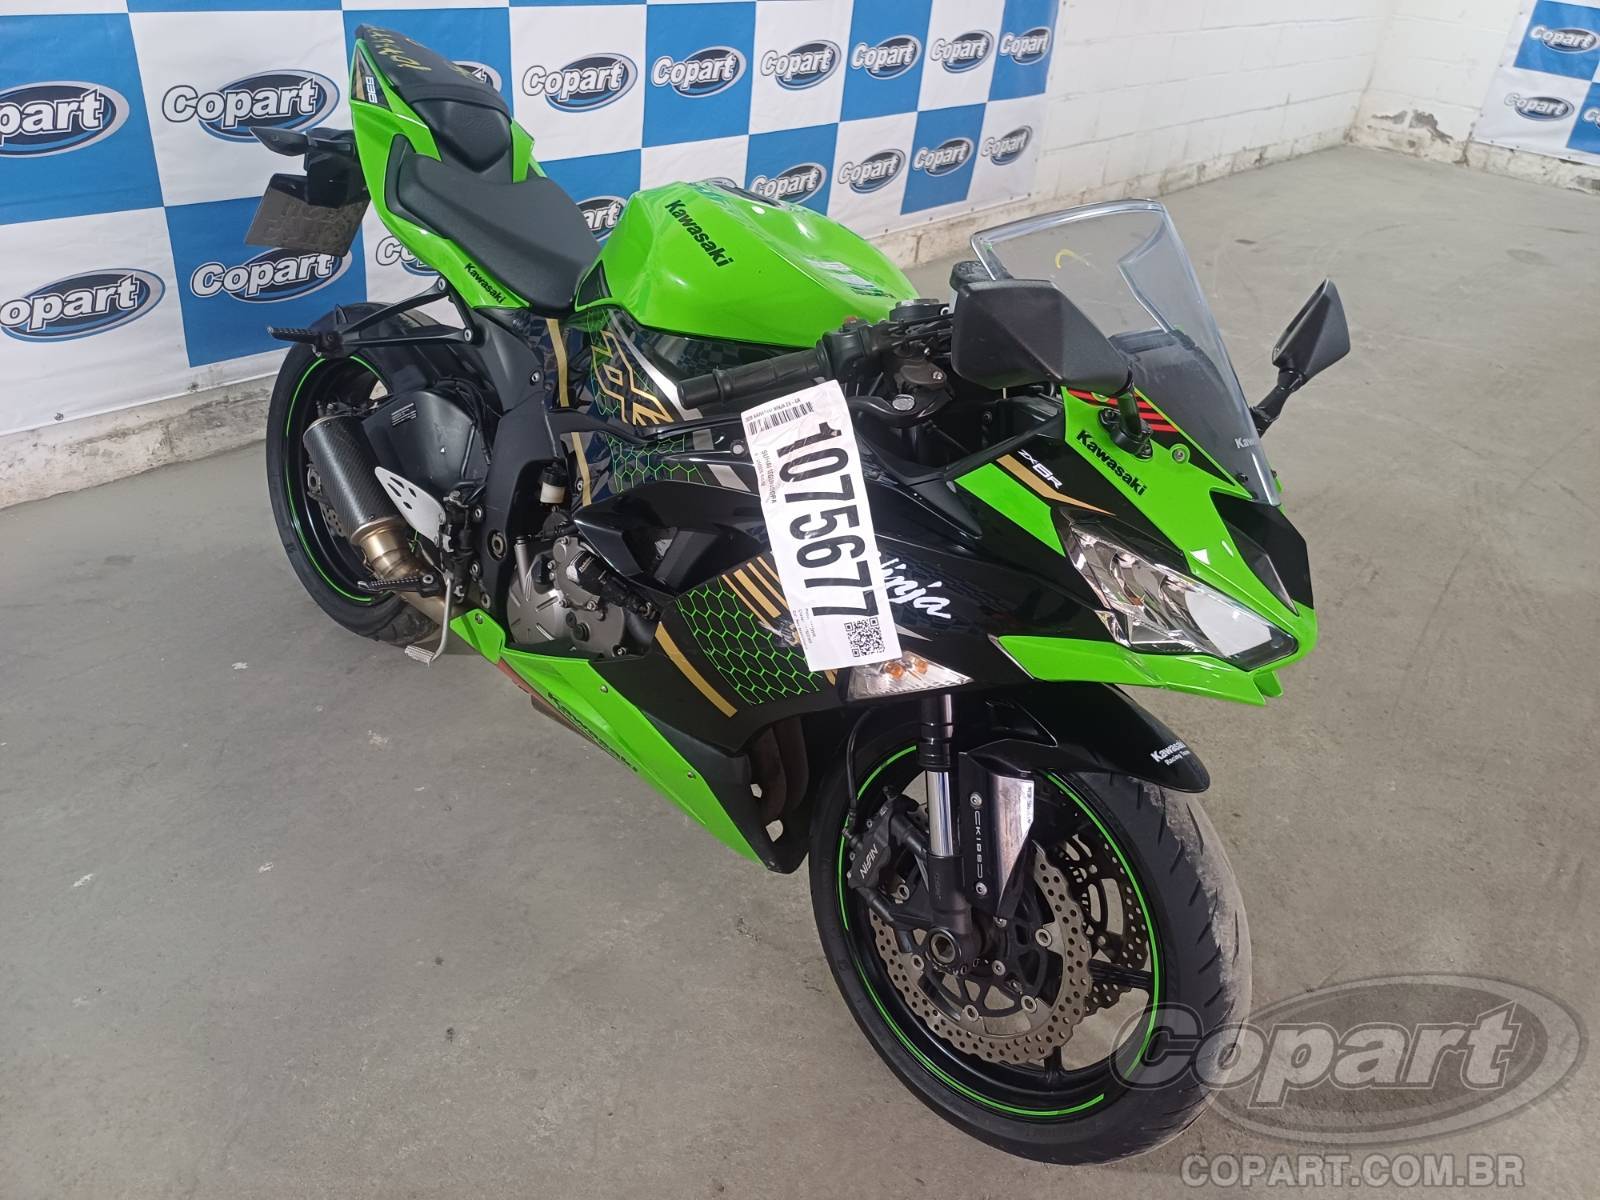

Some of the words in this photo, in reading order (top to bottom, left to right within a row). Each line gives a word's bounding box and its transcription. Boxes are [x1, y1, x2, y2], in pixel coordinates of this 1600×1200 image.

[931, 37, 988, 67] Copart
[1000, 32, 1048, 57] Copart
[1530, 25, 1594, 49] Copart
[651, 53, 736, 90] Copart
[761, 46, 831, 81] Copart
[851, 43, 914, 73] Copart
[522, 59, 623, 100] Copart
[0, 89, 104, 147] part
[162, 78, 315, 129] Copart
[1504, 93, 1566, 117] Copart
[913, 141, 967, 173] Copart
[981, 132, 1027, 161] Copart
[751, 168, 818, 200] Copart
[838, 155, 899, 186] Copart
[584, 200, 620, 231] art
[665, 199, 734, 267] Kawasaki
[190, 253, 334, 298] Copart
[464, 262, 507, 304] Kawasaki
[0, 273, 139, 332] opart
[1076, 430, 1147, 497] Kawasaki
[776, 422, 879, 617] 1075677
